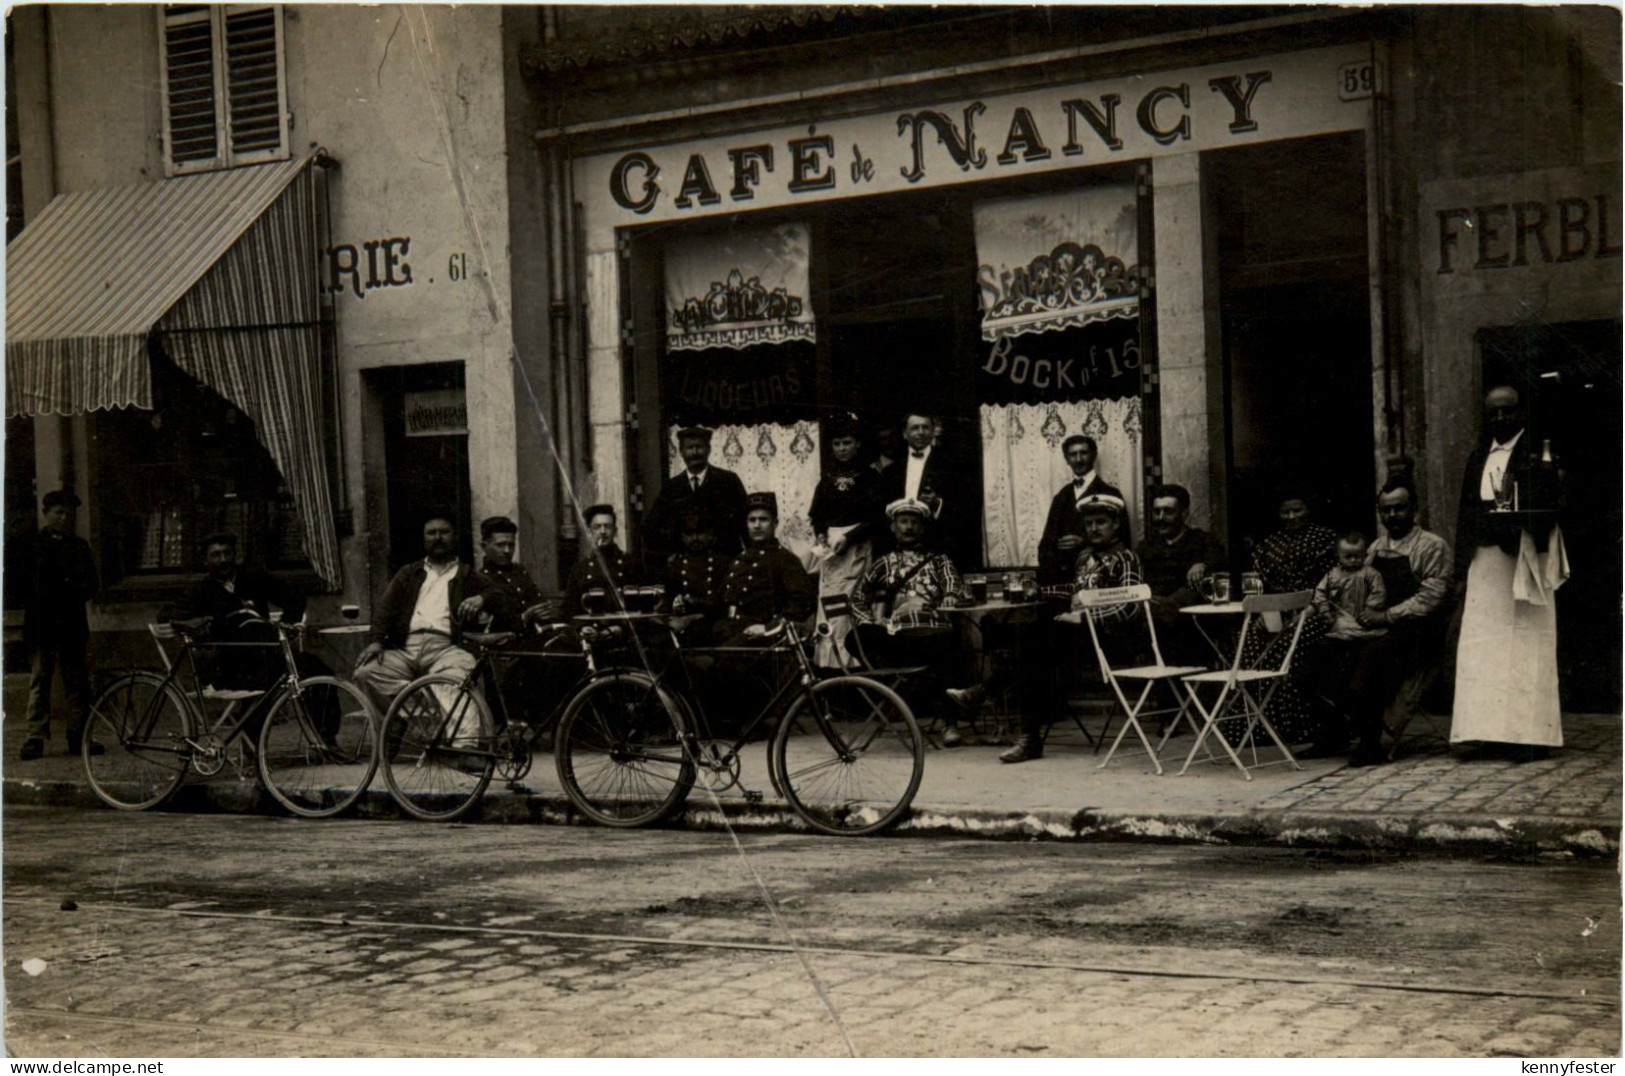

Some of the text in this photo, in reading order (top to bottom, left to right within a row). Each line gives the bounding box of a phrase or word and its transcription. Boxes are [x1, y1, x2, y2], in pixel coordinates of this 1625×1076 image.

[1344, 66, 1373, 93] 59
[610, 70, 1272, 214] CAFÉ de NANCY
[448, 252, 467, 282] 61
[1104, 338, 1141, 378] 15
